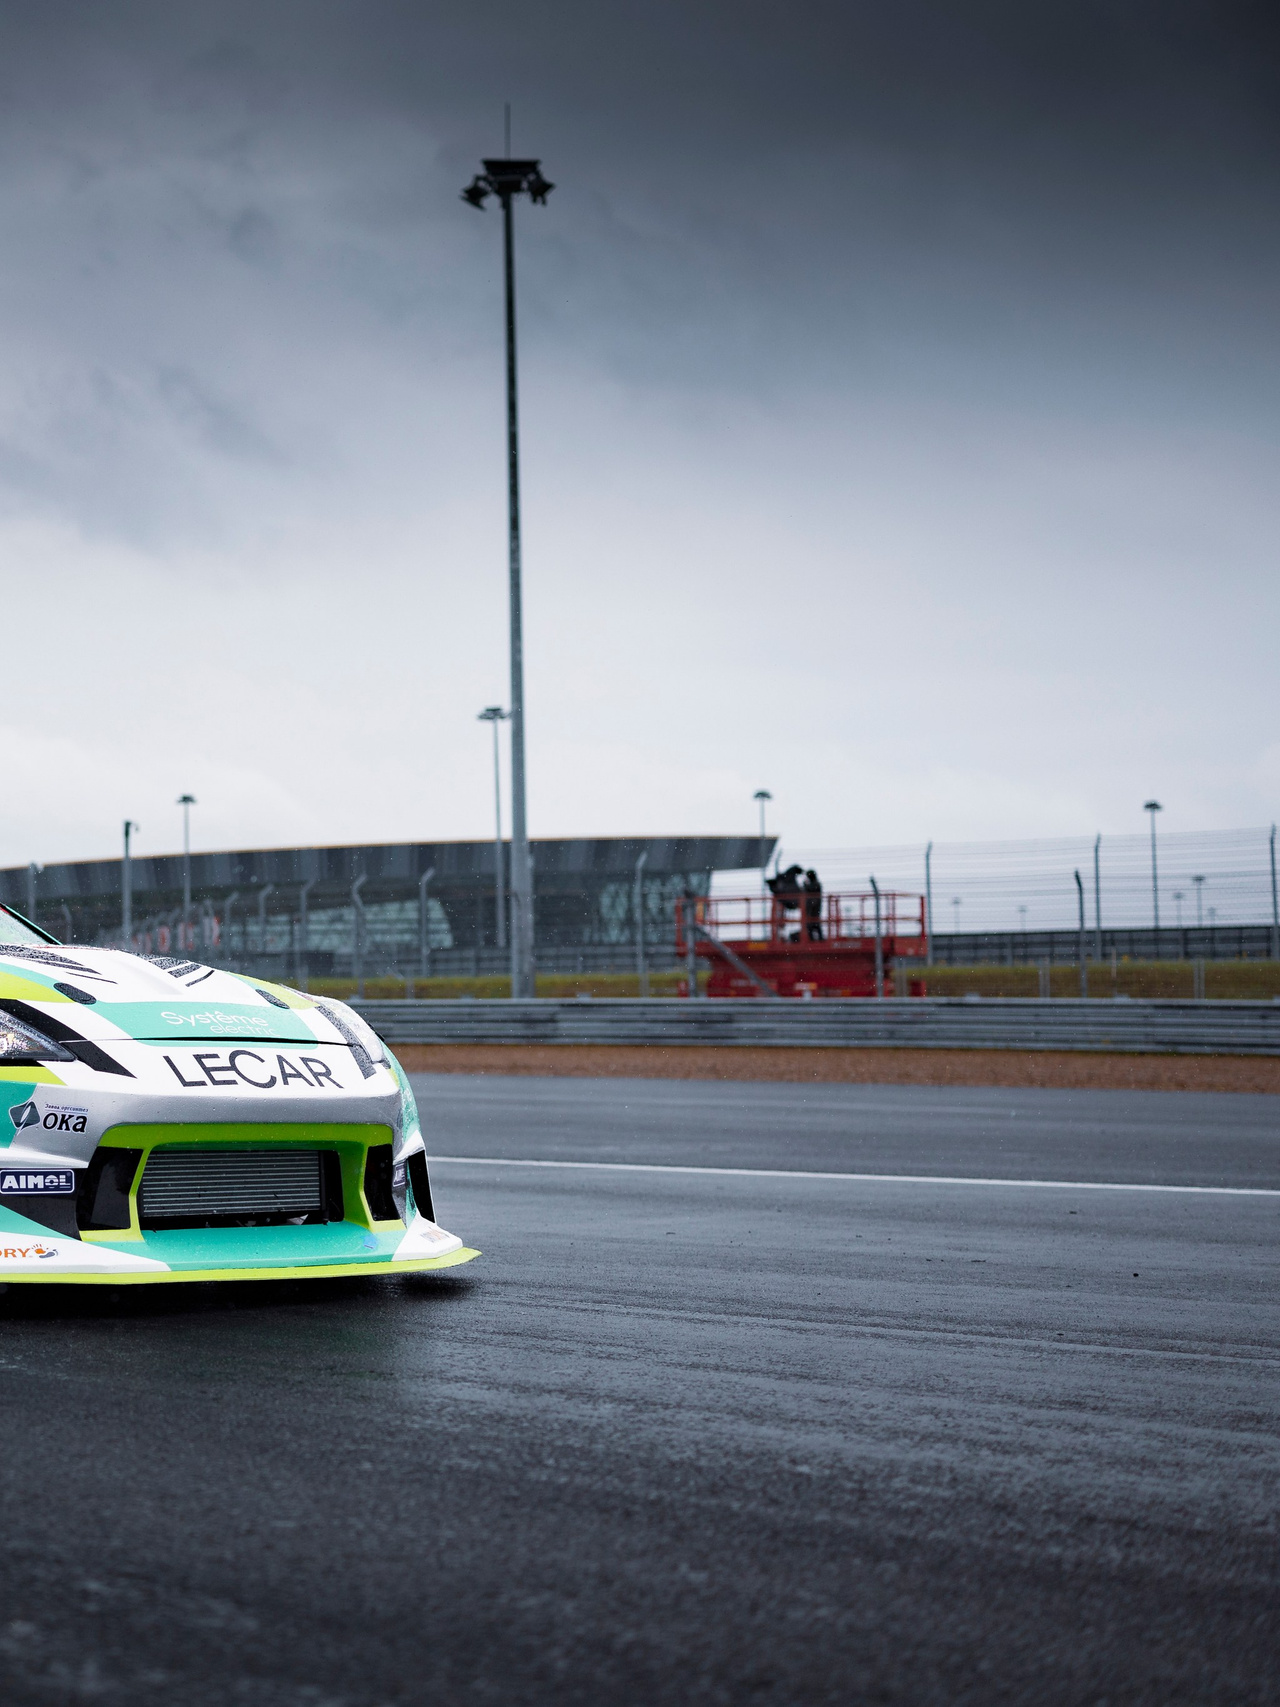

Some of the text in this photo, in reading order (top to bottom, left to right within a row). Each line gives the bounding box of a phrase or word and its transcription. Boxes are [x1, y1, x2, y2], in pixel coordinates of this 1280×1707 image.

[160, 1010, 269, 1027] Systême
[209, 1021, 281, 1037] electric
[162, 1050, 345, 1090] LECAR
[1, 1174, 71, 1189] AIMOL
